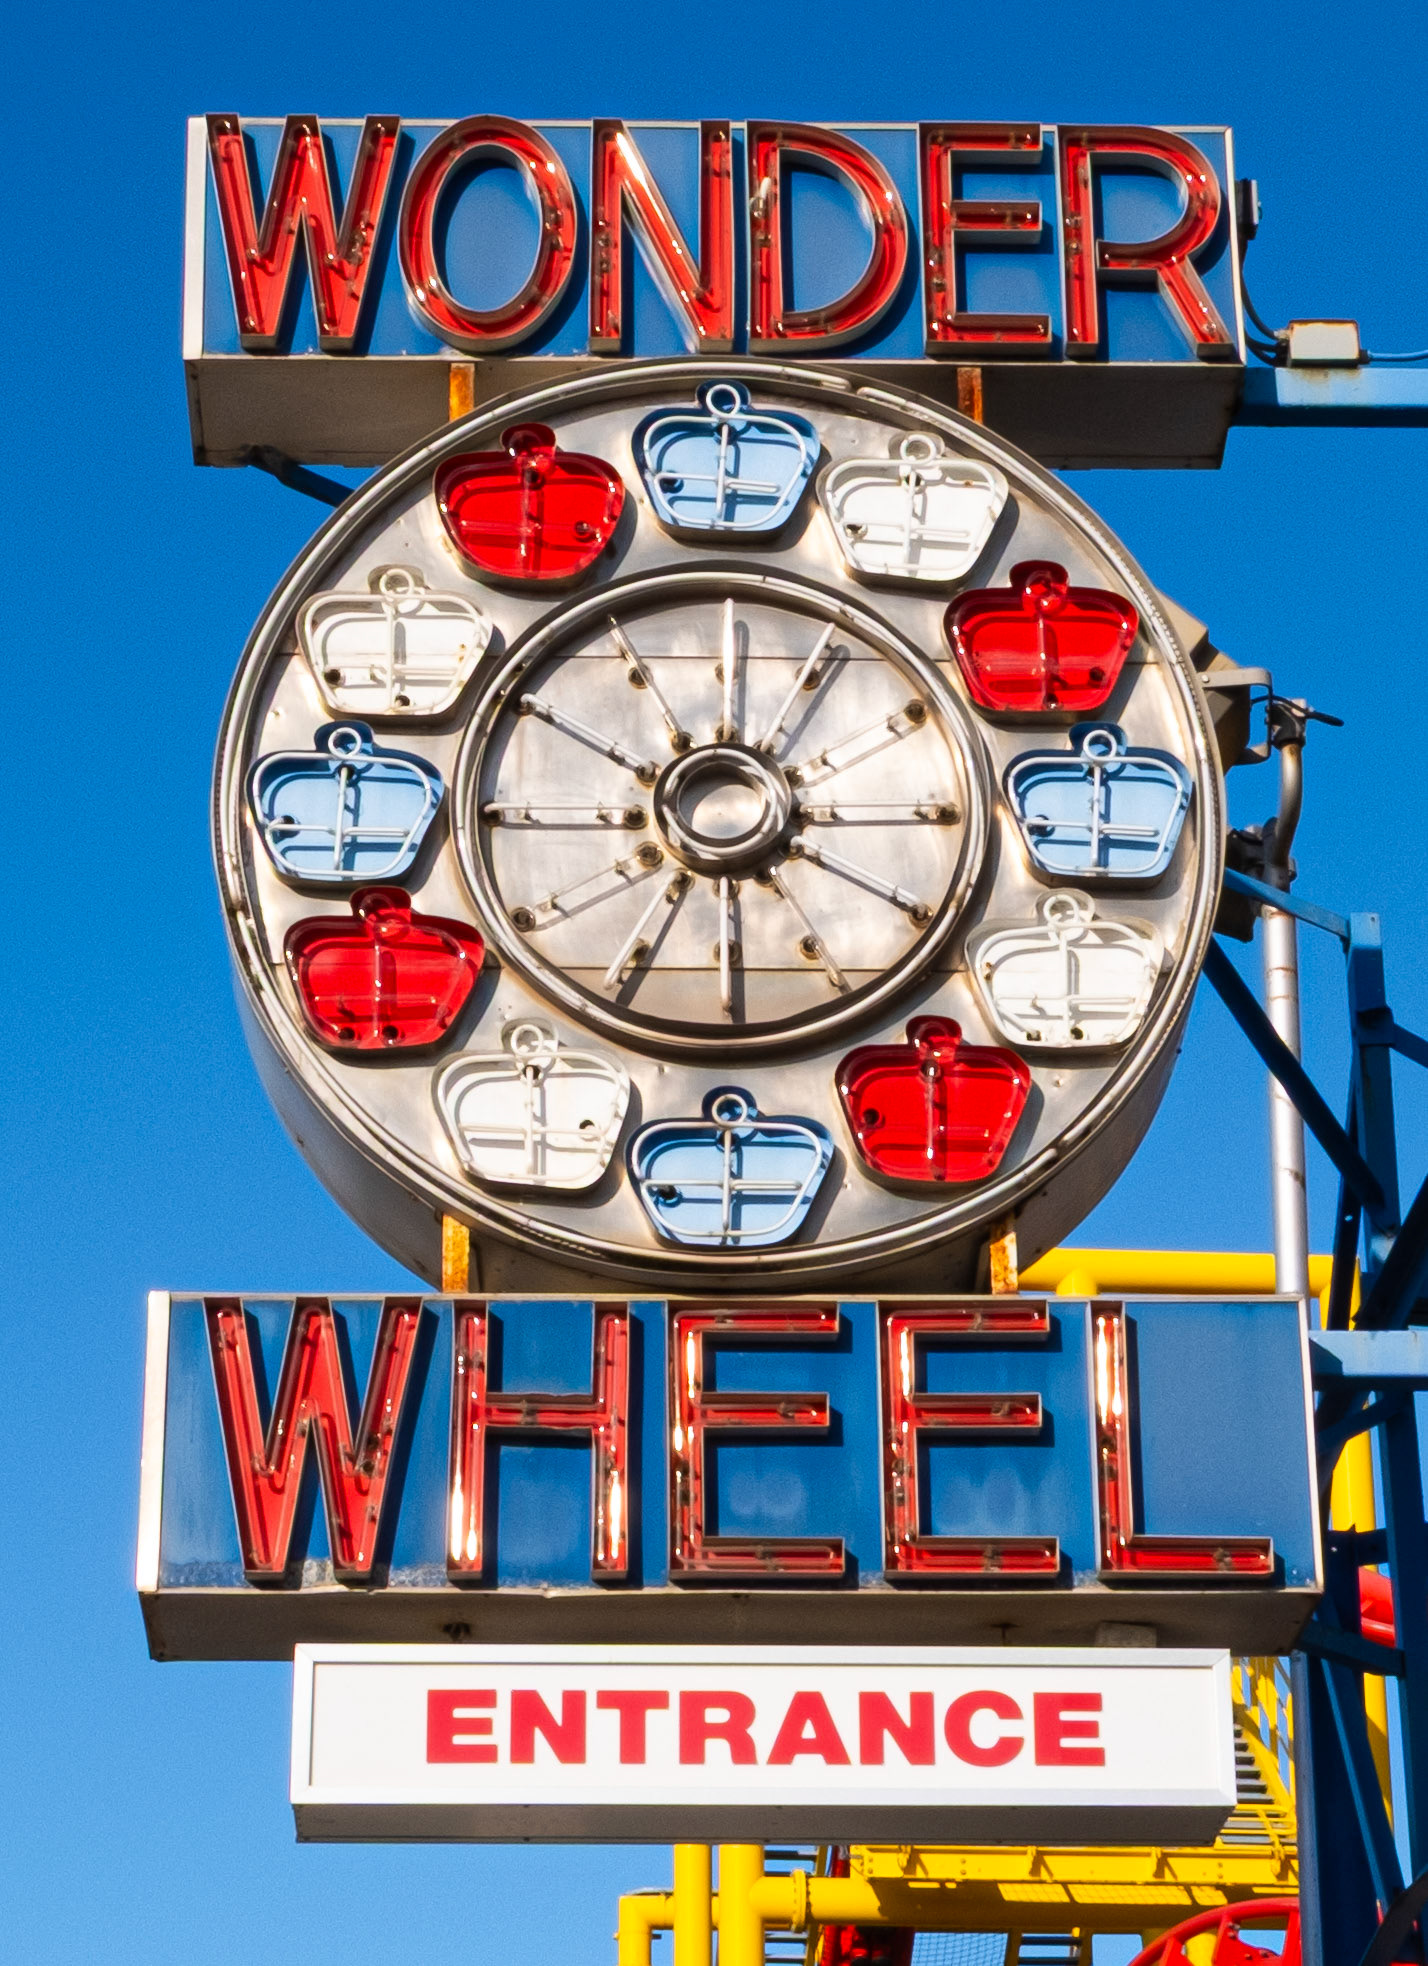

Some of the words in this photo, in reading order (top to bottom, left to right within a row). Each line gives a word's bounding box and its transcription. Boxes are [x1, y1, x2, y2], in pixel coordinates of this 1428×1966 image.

[206, 113, 1235, 361] WONDER
[206, 1297, 1277, 1582] WHEEL
[426, 1689, 1105, 1767] ENTRANCE
